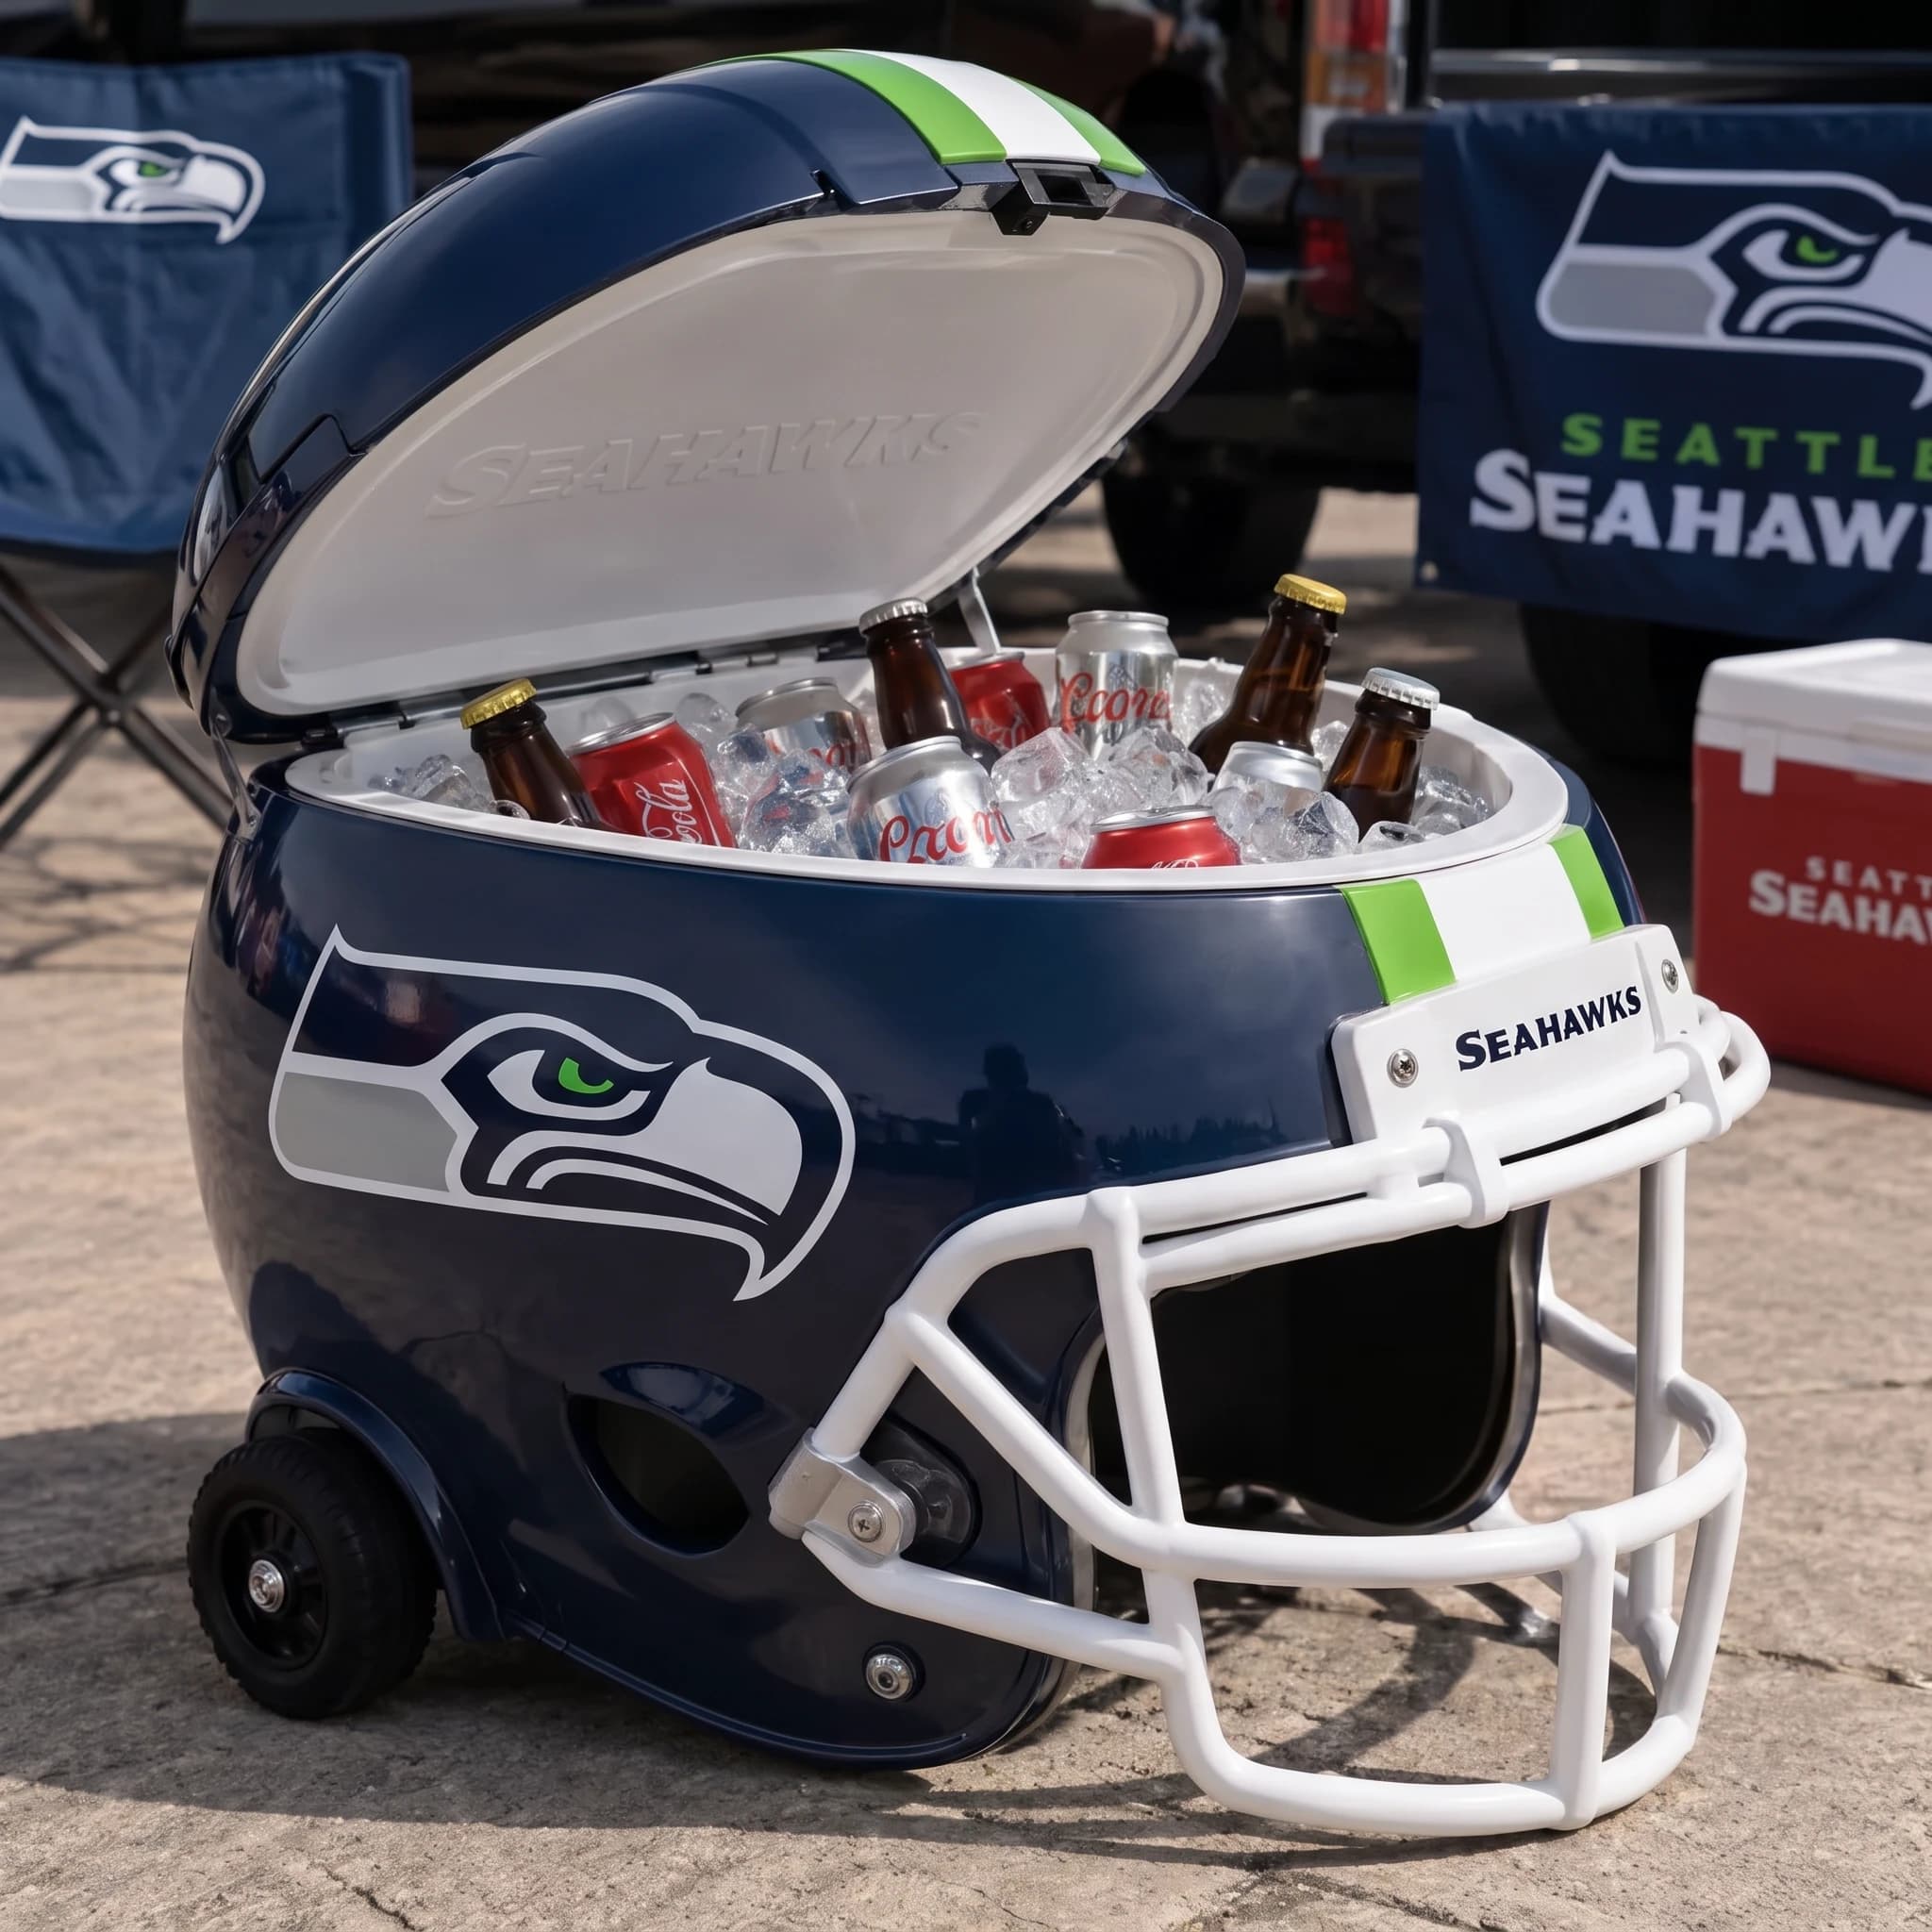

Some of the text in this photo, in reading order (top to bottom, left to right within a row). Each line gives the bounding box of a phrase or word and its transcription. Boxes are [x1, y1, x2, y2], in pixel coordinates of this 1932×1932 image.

[422, 410, 988, 521] SEAHAWKS
[1470, 448, 1932, 575] SEAHAW
[1748, 869, 1932, 945] SEAHA
[1456, 986, 1641, 1072] SEAHAWKS
